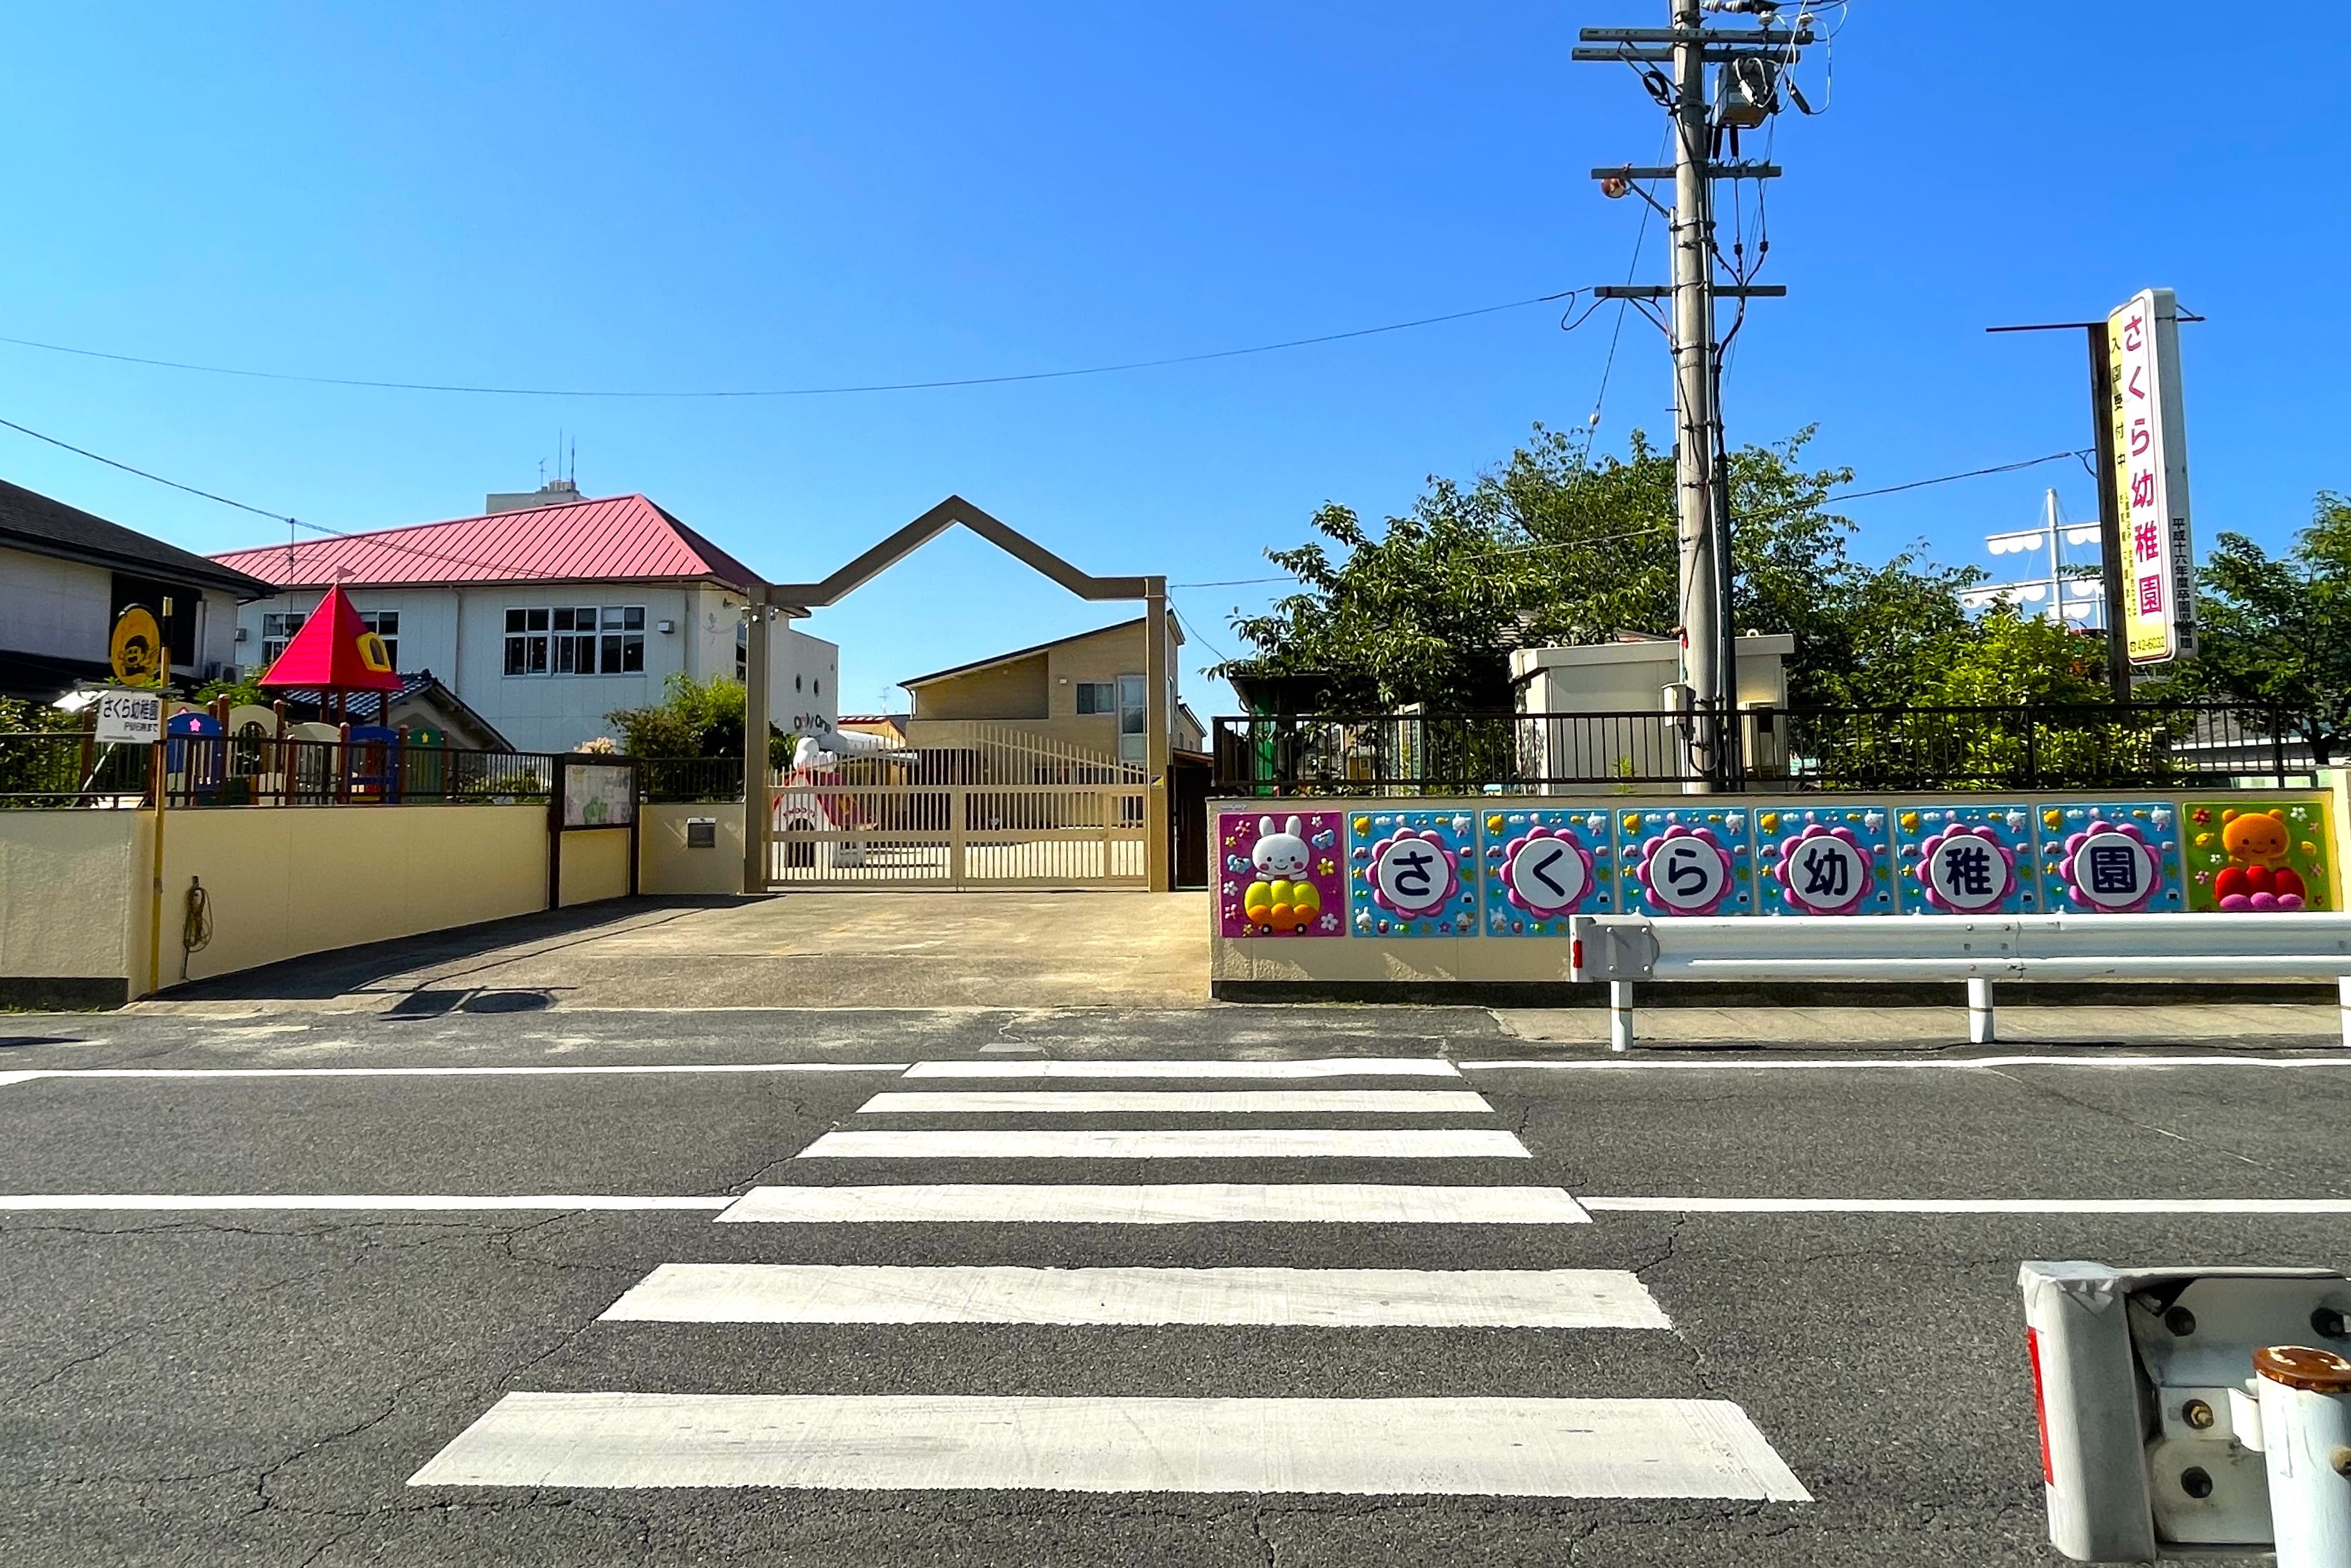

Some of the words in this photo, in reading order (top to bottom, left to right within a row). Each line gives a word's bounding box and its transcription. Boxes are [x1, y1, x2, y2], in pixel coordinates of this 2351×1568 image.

[2111, 337, 2126, 469] 入園受付中
[2124, 315, 2163, 617] さくら幼稚園
[103, 697, 159, 720] さくら幼稚園
[1392, 846, 2138, 897] さくら幼稚園
